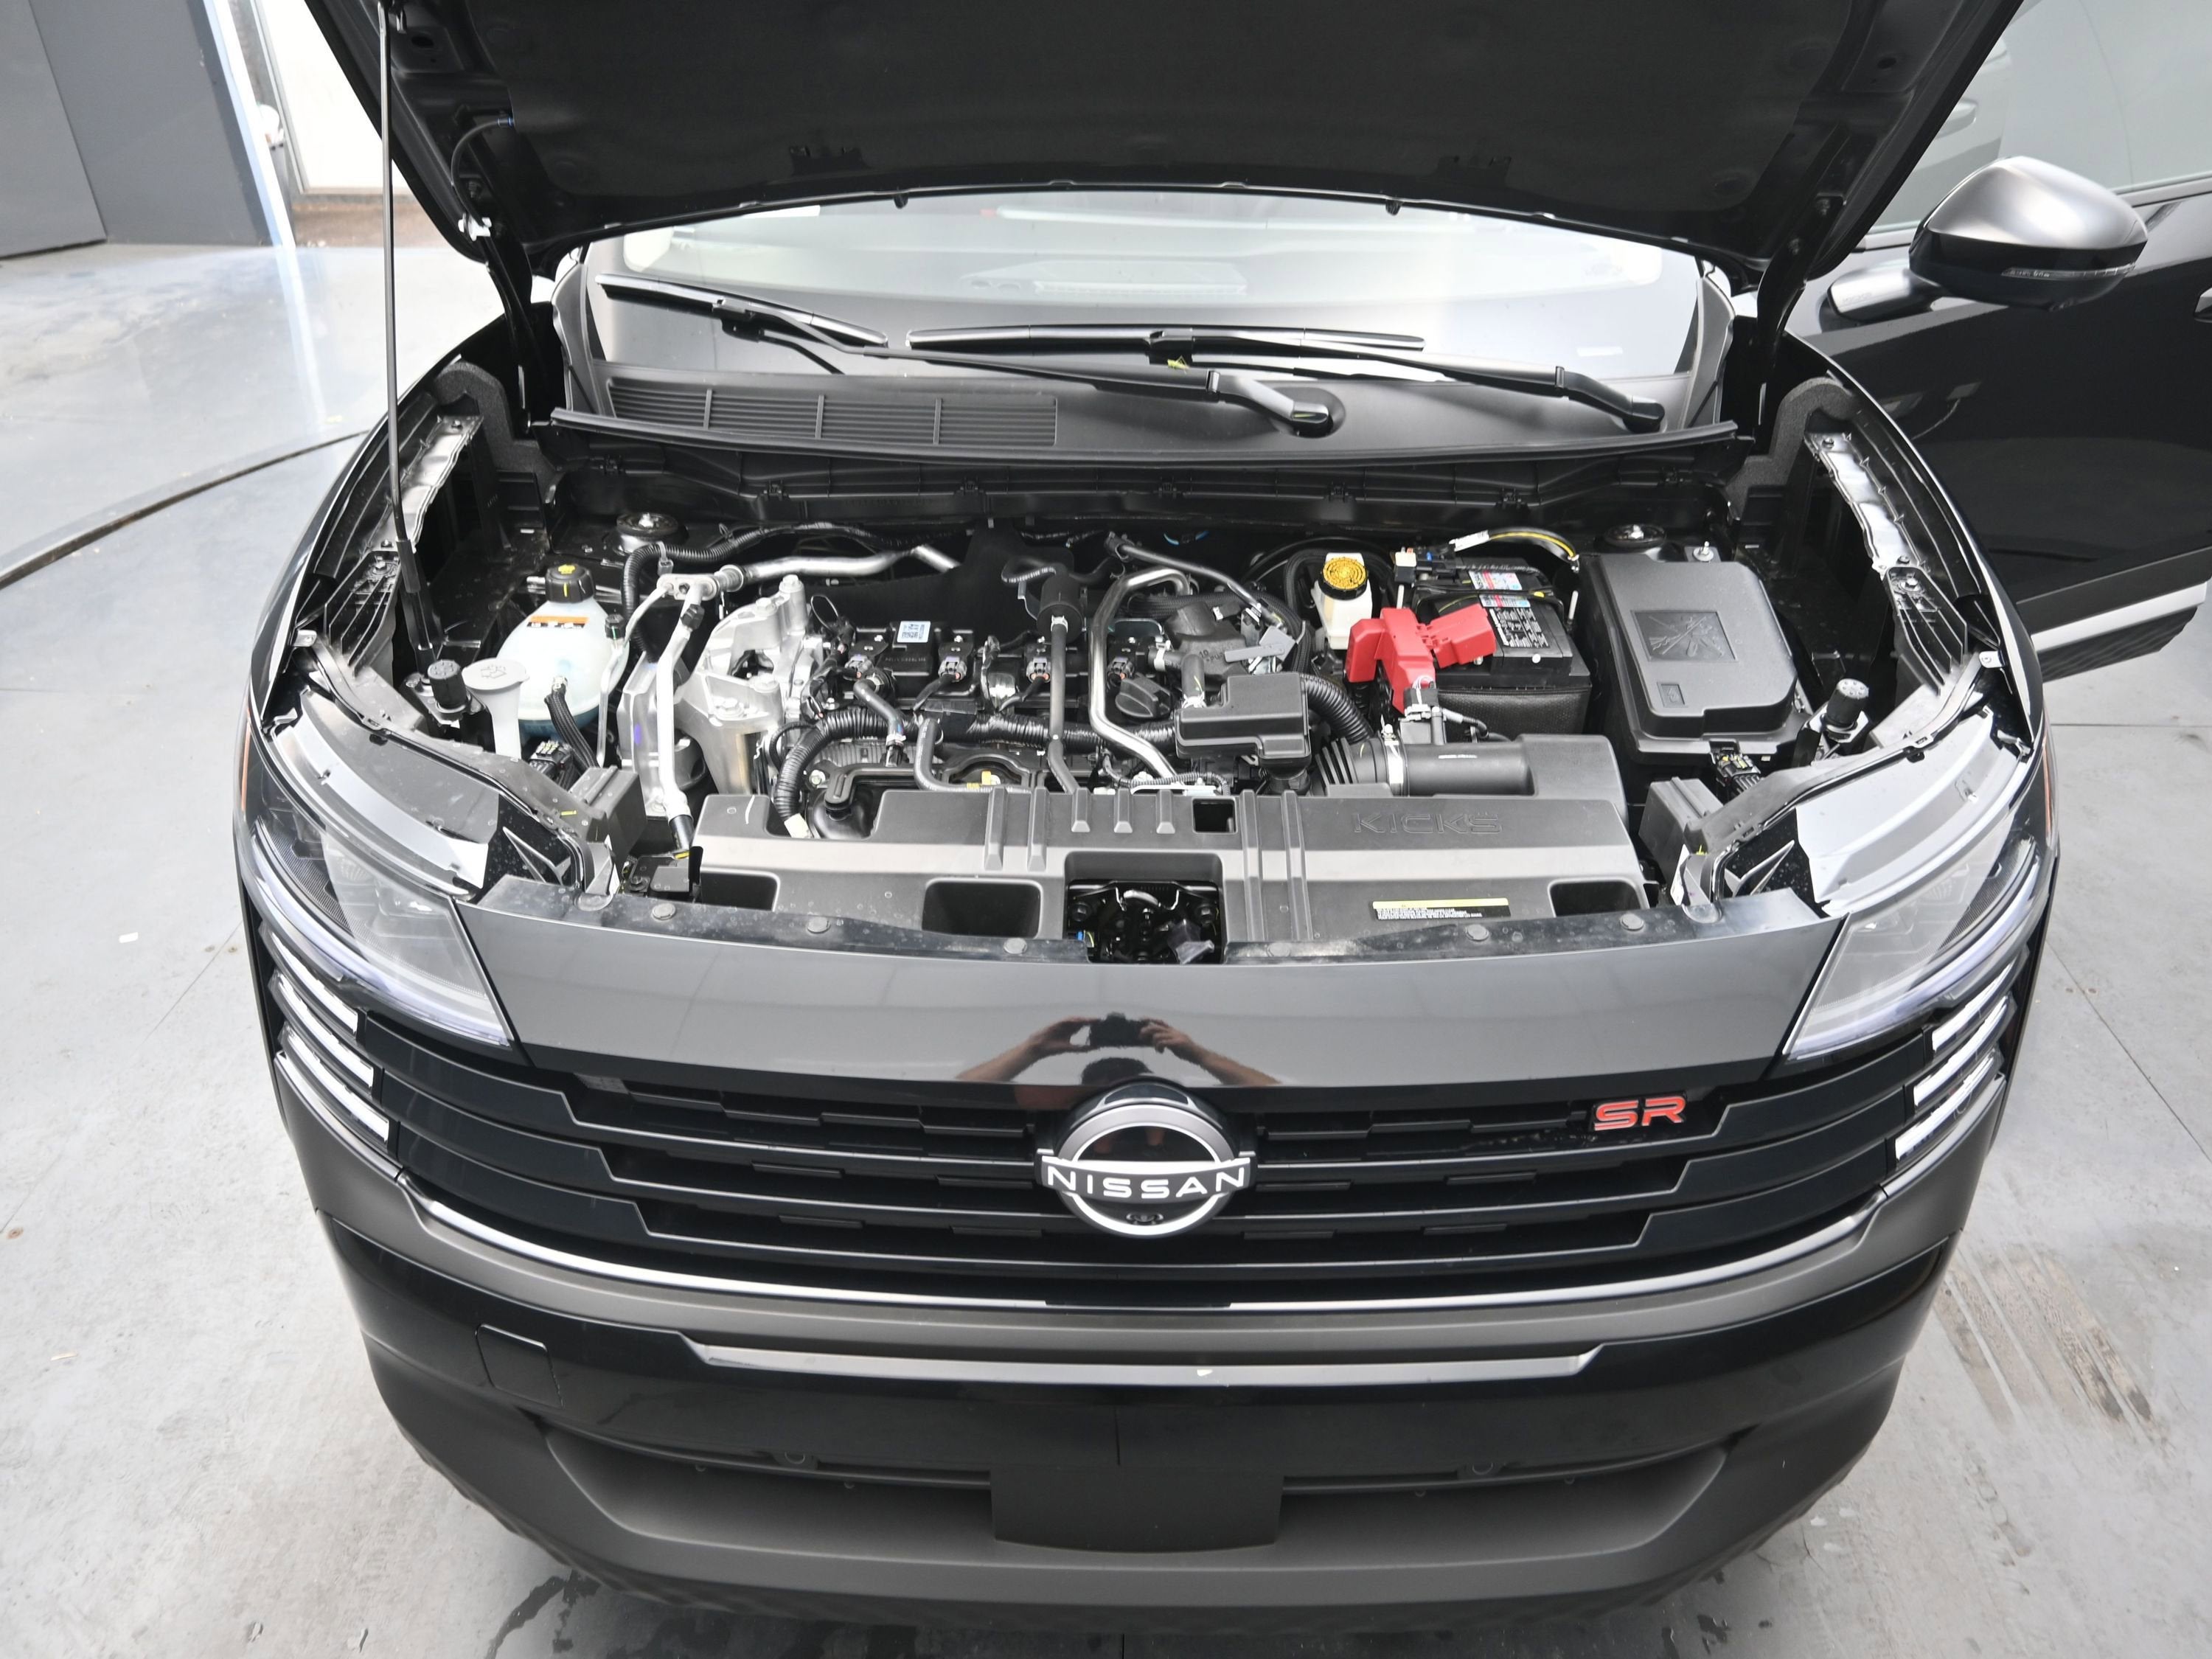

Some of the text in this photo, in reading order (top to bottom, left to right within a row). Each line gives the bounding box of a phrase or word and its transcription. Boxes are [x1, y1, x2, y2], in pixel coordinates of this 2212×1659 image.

[1353, 813, 1503, 834] KICKS
[1594, 1096, 1686, 1131] SR
[1047, 1166, 1245, 1199] NISSAN
